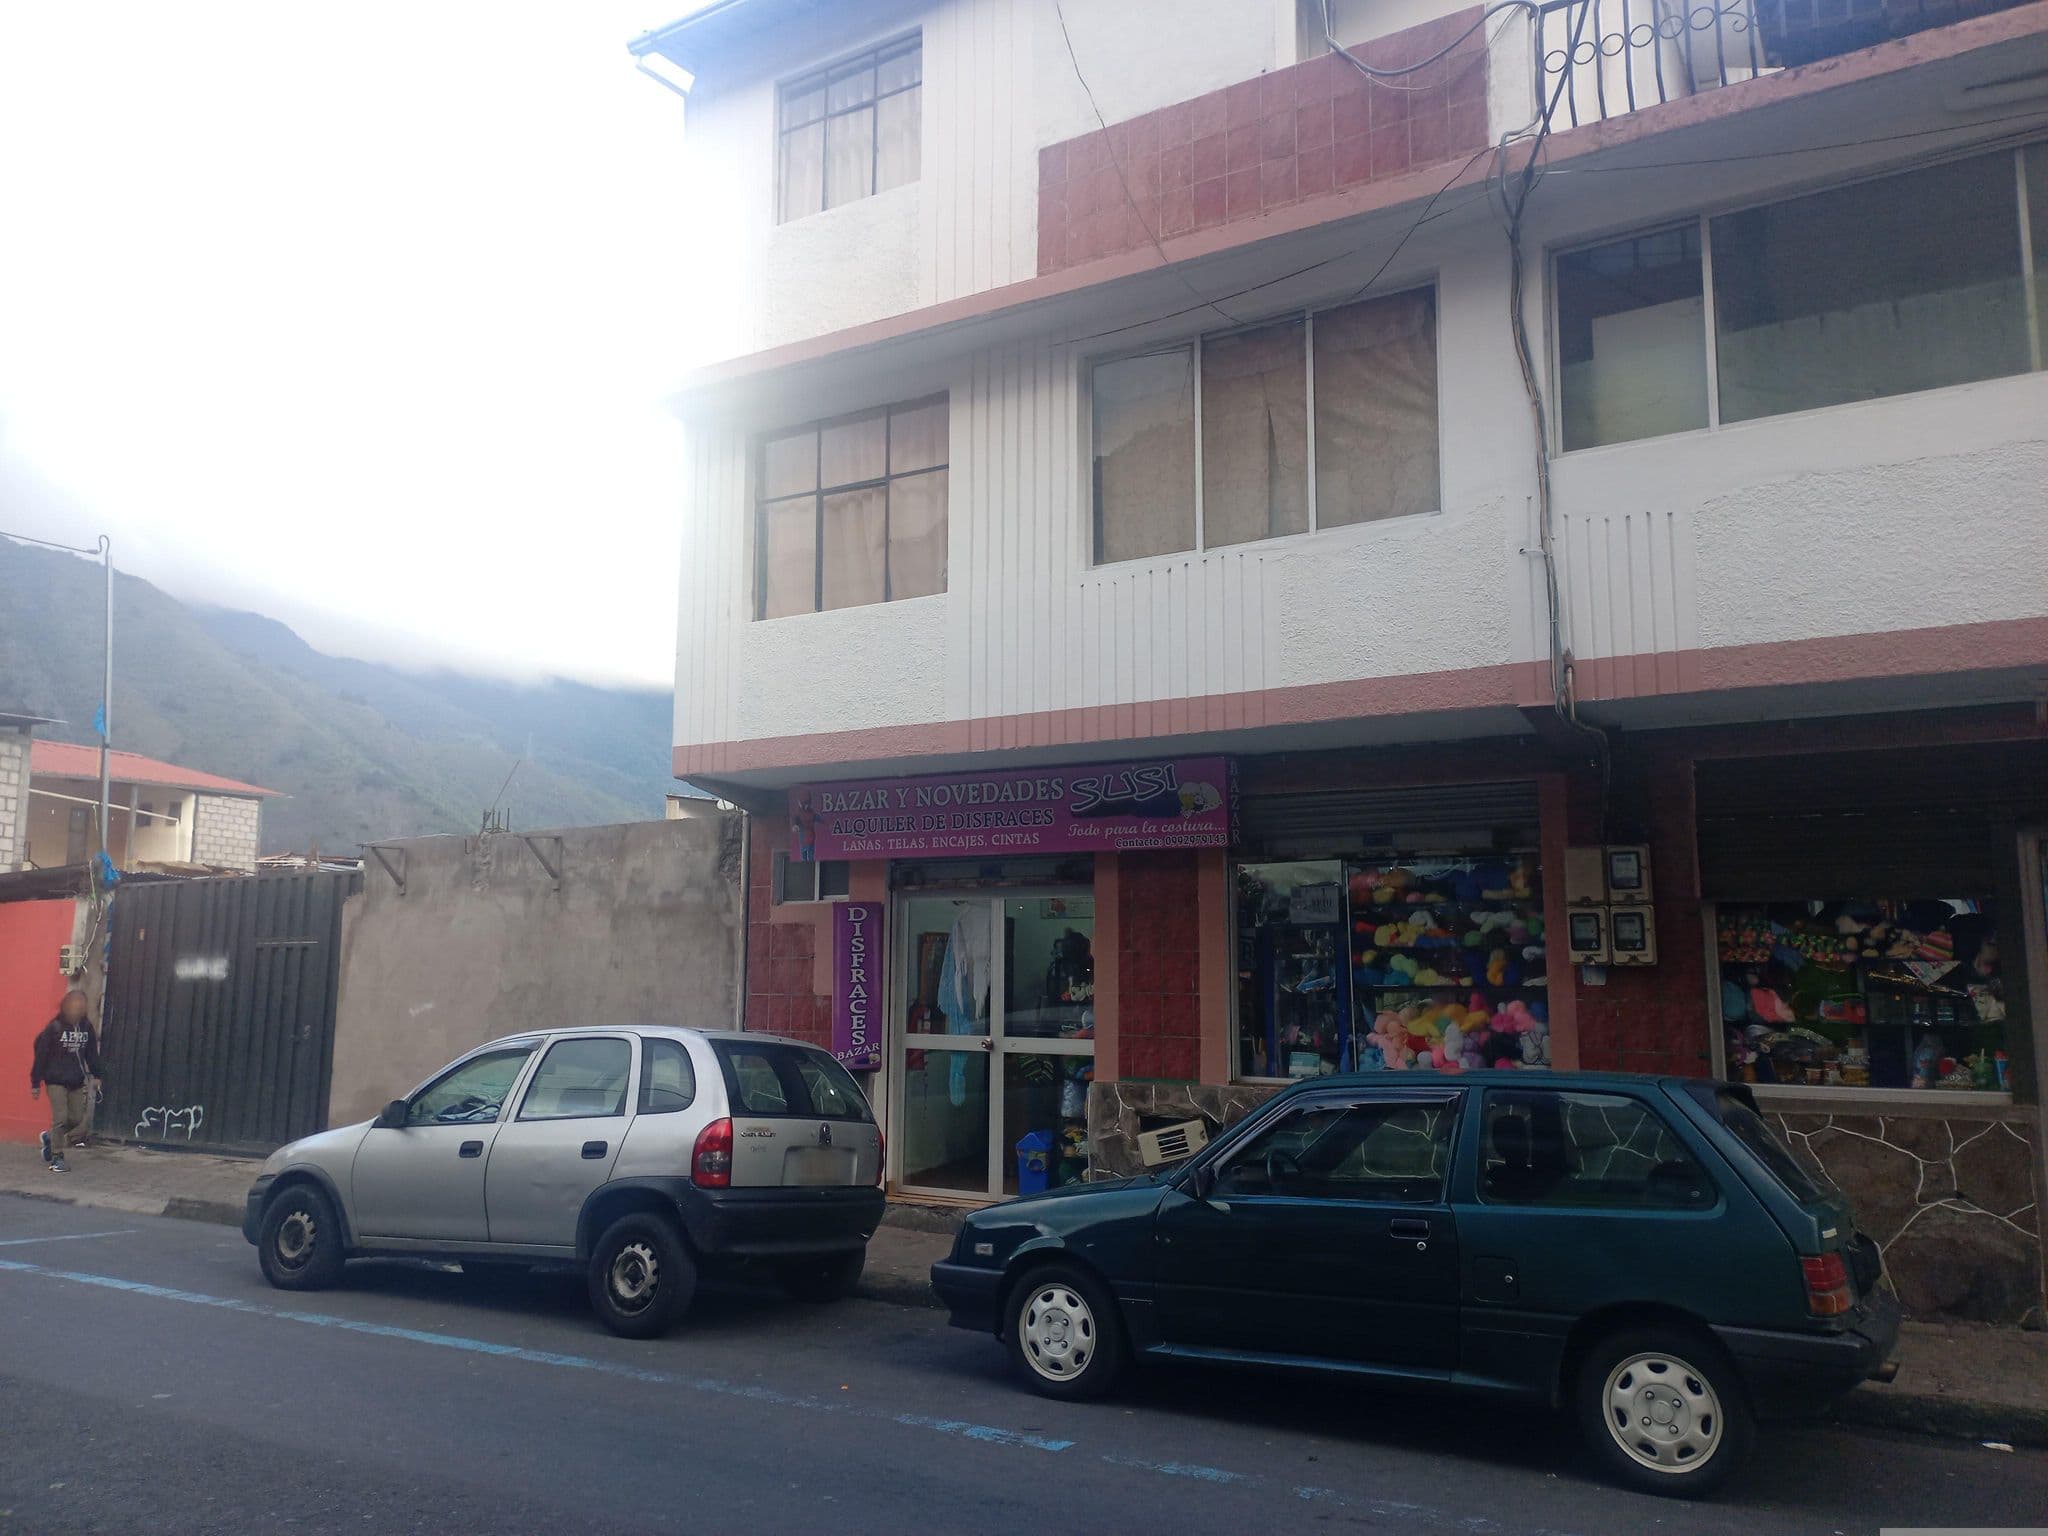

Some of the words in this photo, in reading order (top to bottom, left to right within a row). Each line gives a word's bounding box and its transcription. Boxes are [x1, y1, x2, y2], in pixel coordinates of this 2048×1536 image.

[822, 789, 889, 812] BAZAR
[895, 787, 911, 808] Y
[917, 777, 1063, 806] NOVEDADES
[1070, 763, 1178, 812] SUSI
[1230, 761, 1241, 846] BAZAR
[833, 815, 915, 837] ALQUILER
[922, 814, 946, 831] DE
[952, 808, 1055, 829] DISFRACES
[1068, 823, 1101, 838] Todo
[1103, 822, 1137, 839] para
[1141, 820, 1157, 833] la
[888, 837, 928, 850] TELAS,
[932, 834, 988, 850] ENCAJES,
[992, 832, 1040, 846] CINTAS
[1114, 837, 1162, 849] Contacto:
[847, 907, 868, 1045] DISFRACES
[837, 1042, 881, 1062] BAZAR
